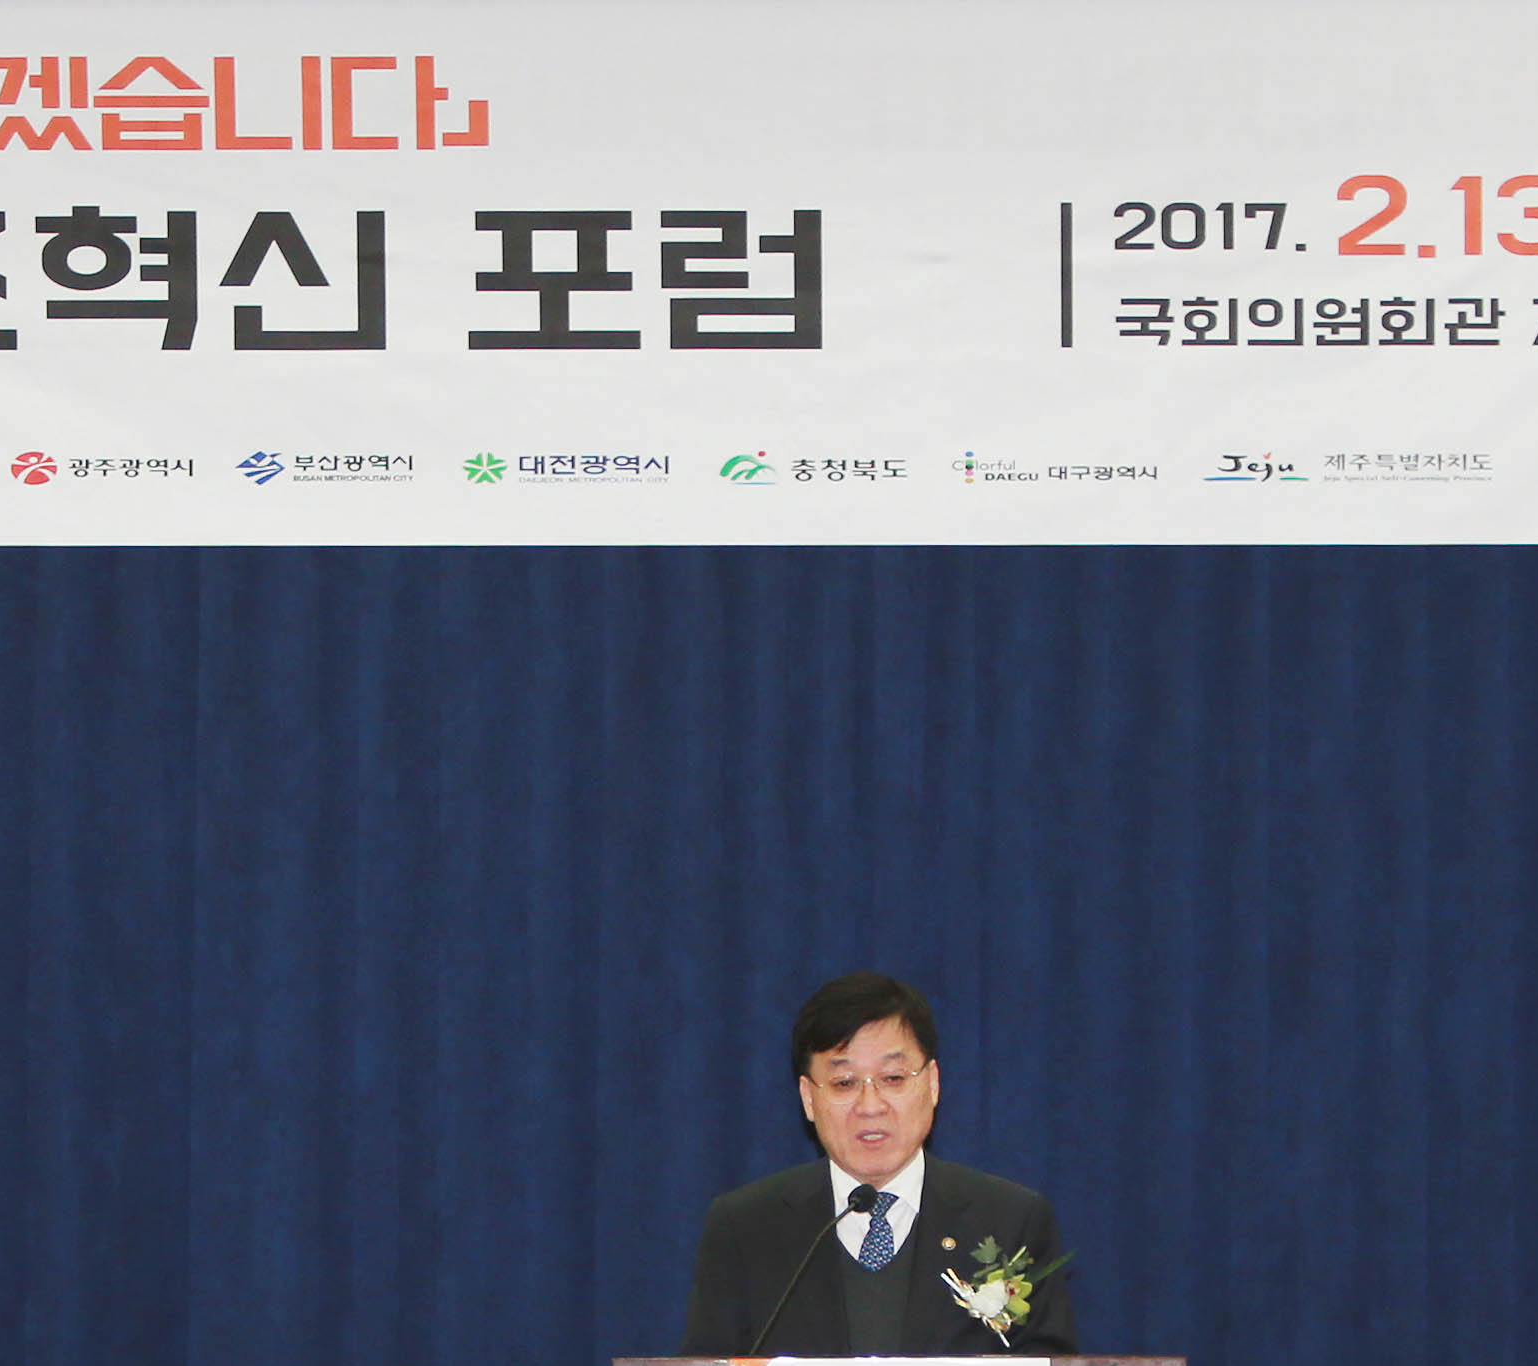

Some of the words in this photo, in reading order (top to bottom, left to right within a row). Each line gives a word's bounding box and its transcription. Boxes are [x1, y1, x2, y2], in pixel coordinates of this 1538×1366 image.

[1113, 201, 1307, 252] 2017.
[467, 209, 823, 351] 포럼
[1115, 296, 1506, 347] 국회의원회관
[68, 458, 194, 478] 광주광역시
[294, 454, 413, 472] 부산광역시
[518, 455, 670, 475] 대전광역시
[791, 458, 907, 482] 충청북도
[1217, 453, 1295, 482] Jeju
[1324, 453, 1493, 472] 제주특별자치도
[292, 474, 323, 482] BUSAN
[392, 474, 414, 482] CITY
[984, 472, 1039, 482] DAEGU
[1048, 465, 1158, 481] 대구광역시
